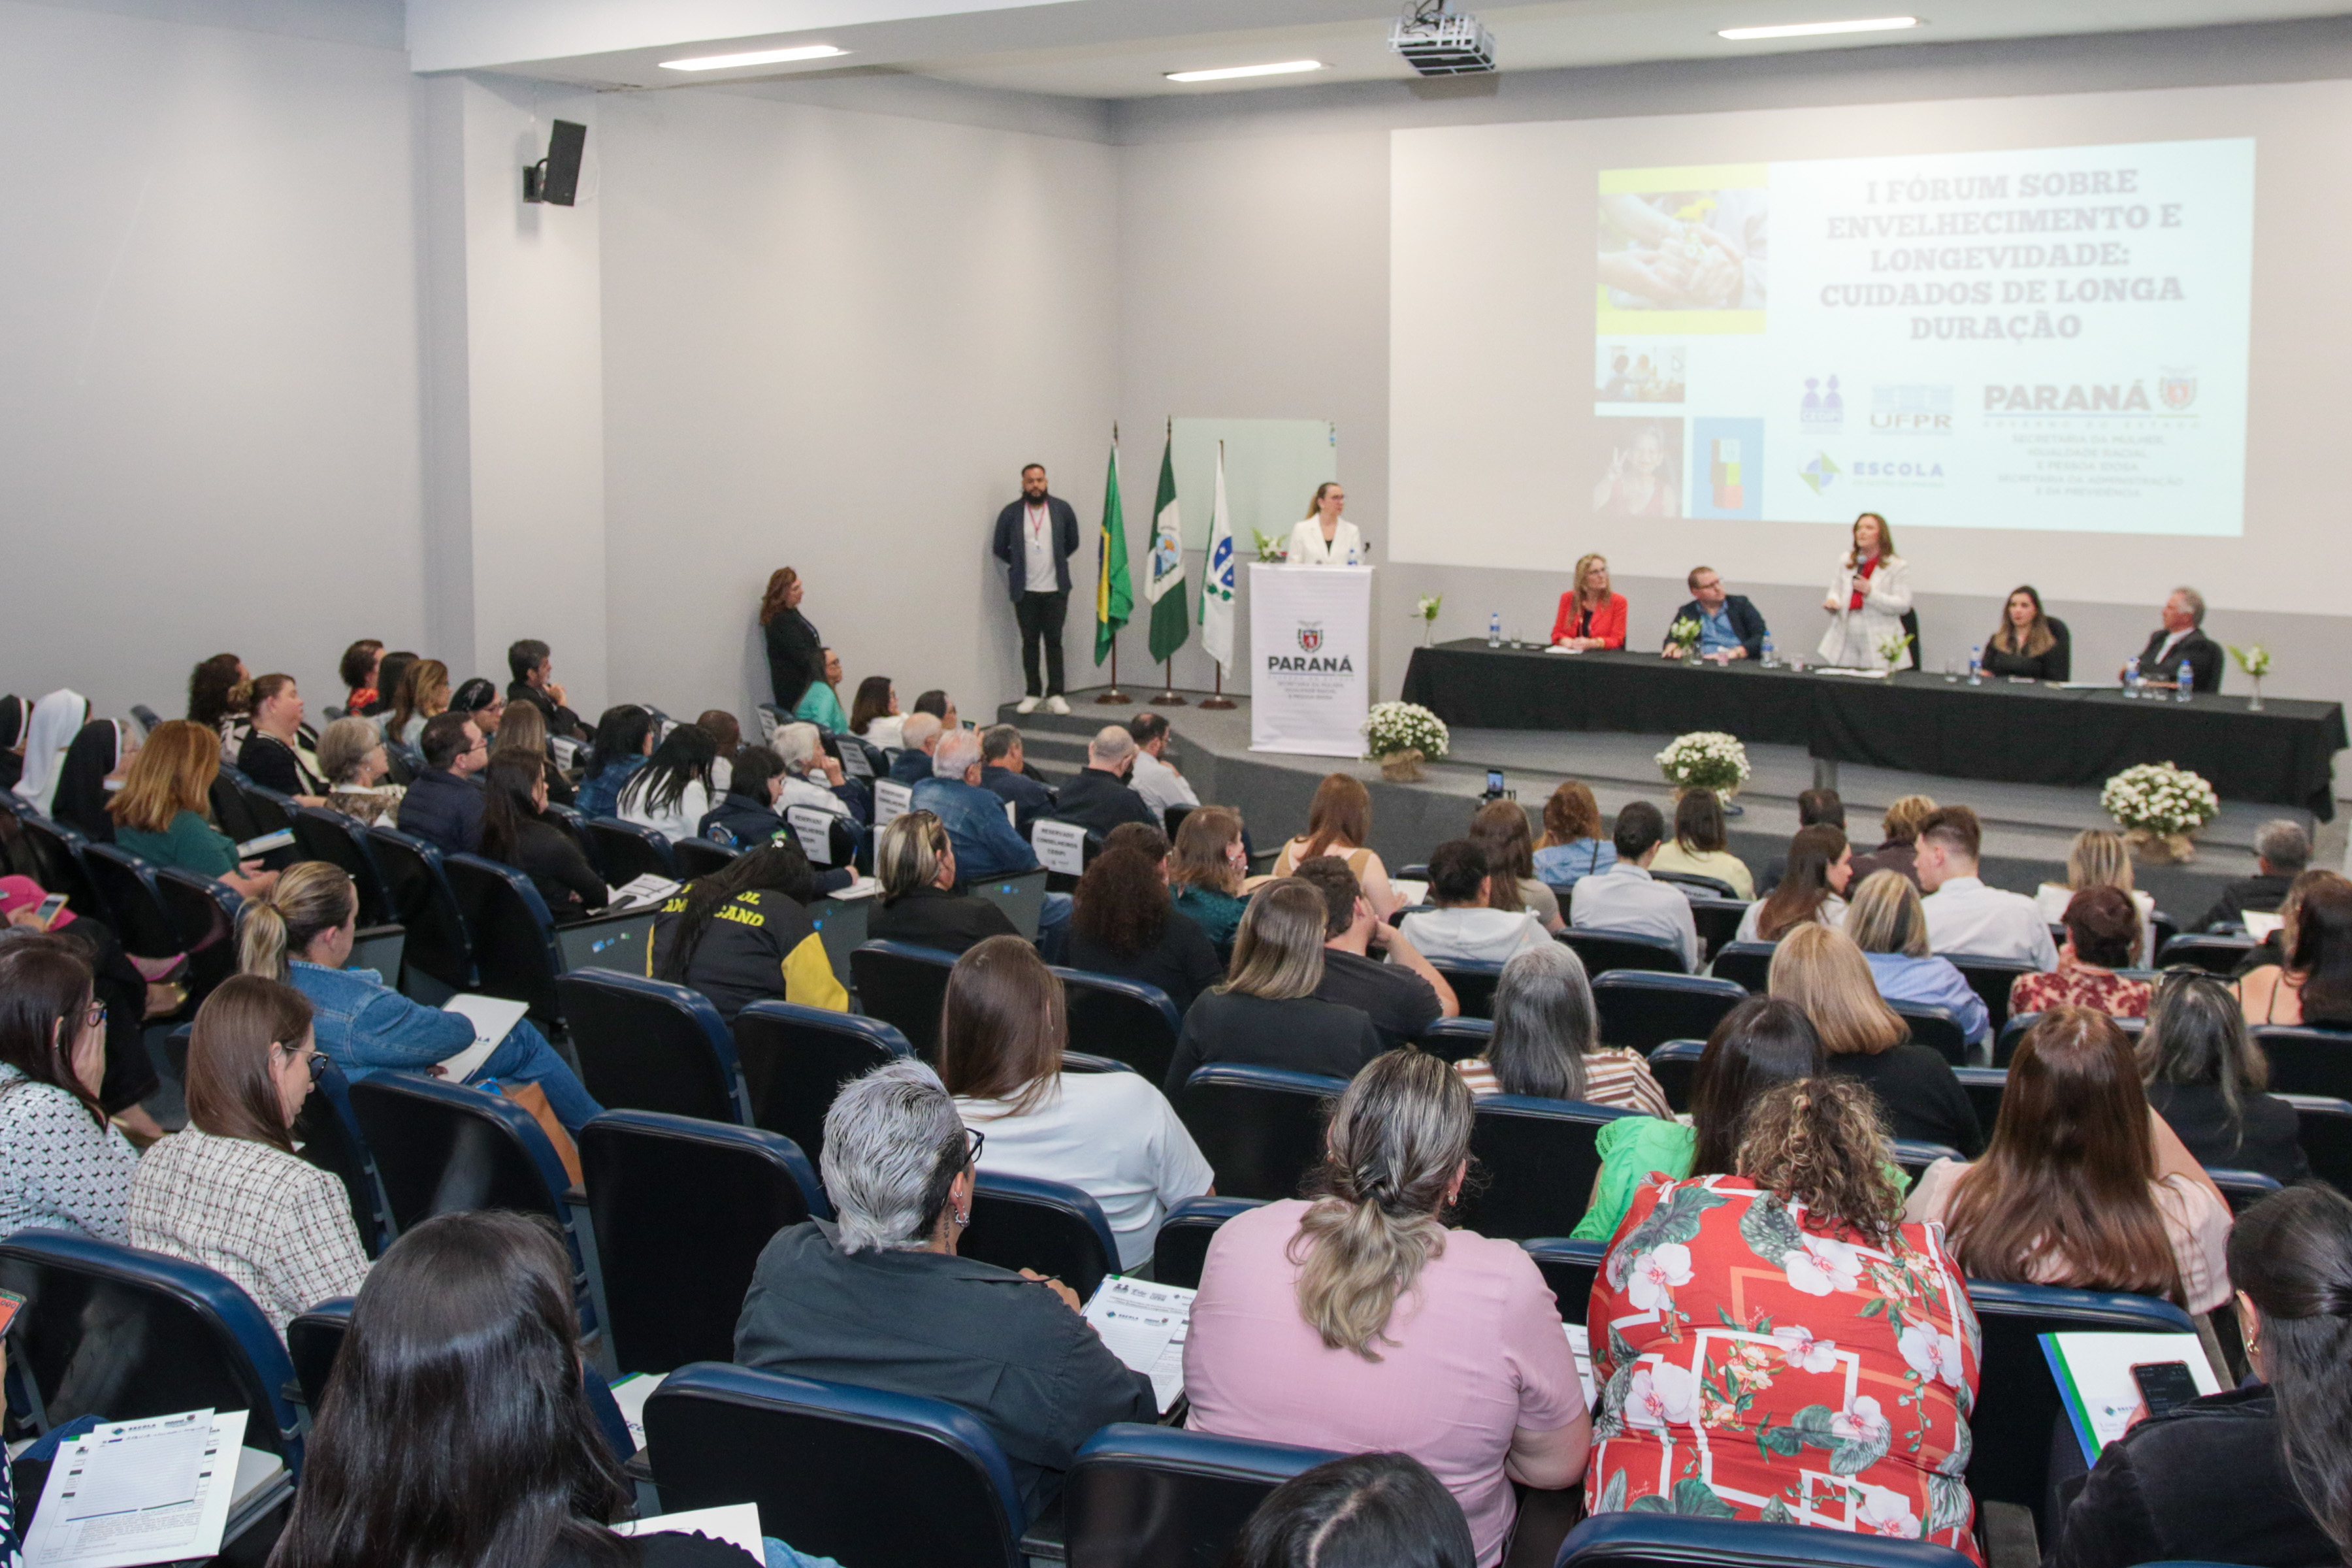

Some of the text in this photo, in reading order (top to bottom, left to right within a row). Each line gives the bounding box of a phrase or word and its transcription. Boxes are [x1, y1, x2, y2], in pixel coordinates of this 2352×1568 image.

[1866, 169, 2138, 205] I FÓRUM SOBRE
[1827, 203, 2183, 240] ENVELHECIMENTO E
[1870, 241, 2131, 272] LONGEVIDADE:
[1820, 276, 2185, 308] CUIDADOS DE LONGA
[1910, 310, 2082, 345] DURAÇÃO
[1984, 379, 2151, 412] PARANÁ
[1869, 414, 1952, 429] UFPR
[1854, 462, 1944, 477] ESCOLA
[1268, 655, 1352, 672] PARANÁ
